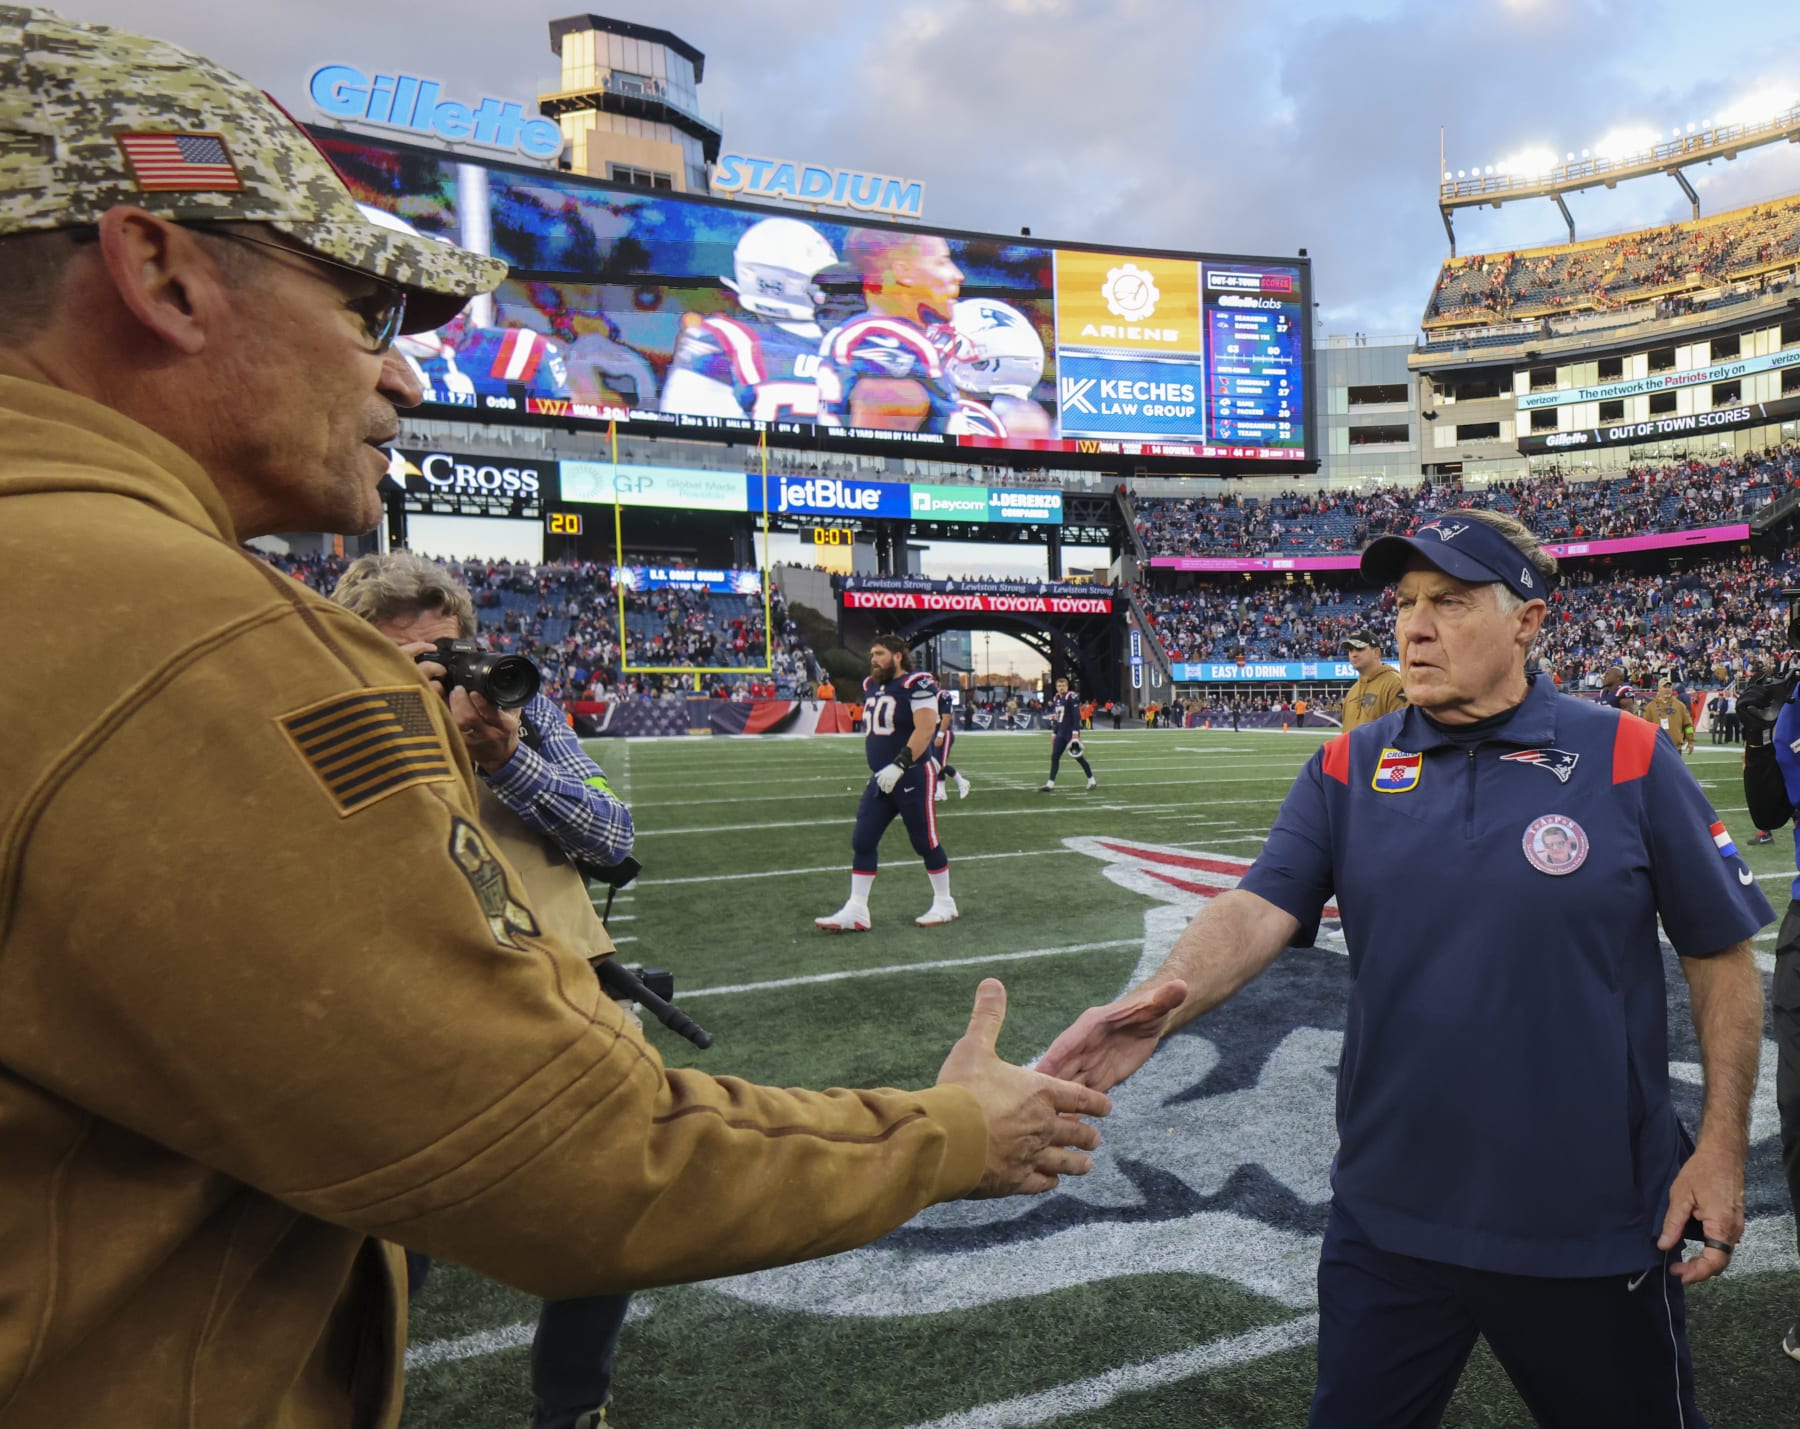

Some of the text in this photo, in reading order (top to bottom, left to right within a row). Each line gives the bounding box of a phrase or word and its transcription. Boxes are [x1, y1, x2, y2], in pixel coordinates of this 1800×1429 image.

[310, 65, 562, 154] Gillette
[716, 154, 922, 213] STADIUM
[1081, 324, 1179, 342] ARIENS
[1772, 354, 1800, 366] verizo
[1100, 380, 1195, 402] KECHES
[1526, 365, 1745, 406] verizon The network the Patriots rely on
[448, 390, 467, 404] 17
[486, 396, 517, 410] 0:08
[1101, 403, 1195, 417] LAW GROUP
[792, 424, 800, 434] 4
[1546, 407, 1750, 447] Gillette OUT OF TOWN SCORES
[422, 454, 540, 491] CROSS
[778, 477, 880, 512] jetBlue
[989, 493, 1061, 509] J.DERENZO
[932, 500, 985, 512] paycom
[551, 514, 578, 533] 20
[814, 528, 852, 545] 0:07
[862, 579, 932, 591] Lewiston Strong
[961, 582, 1026, 593] Lewiston Strong
[1053, 586, 1114, 596] Lewiston Strong
[852, 592, 916, 609] TOYOTA
[922, 595, 983, 610] TOYOTA
[987, 596, 1046, 612] TOYOTA
[1051, 598, 1107, 613] TOYOTA
[1212, 666, 1238, 678] EASY
[1255, 665, 1287, 677] DRINK
